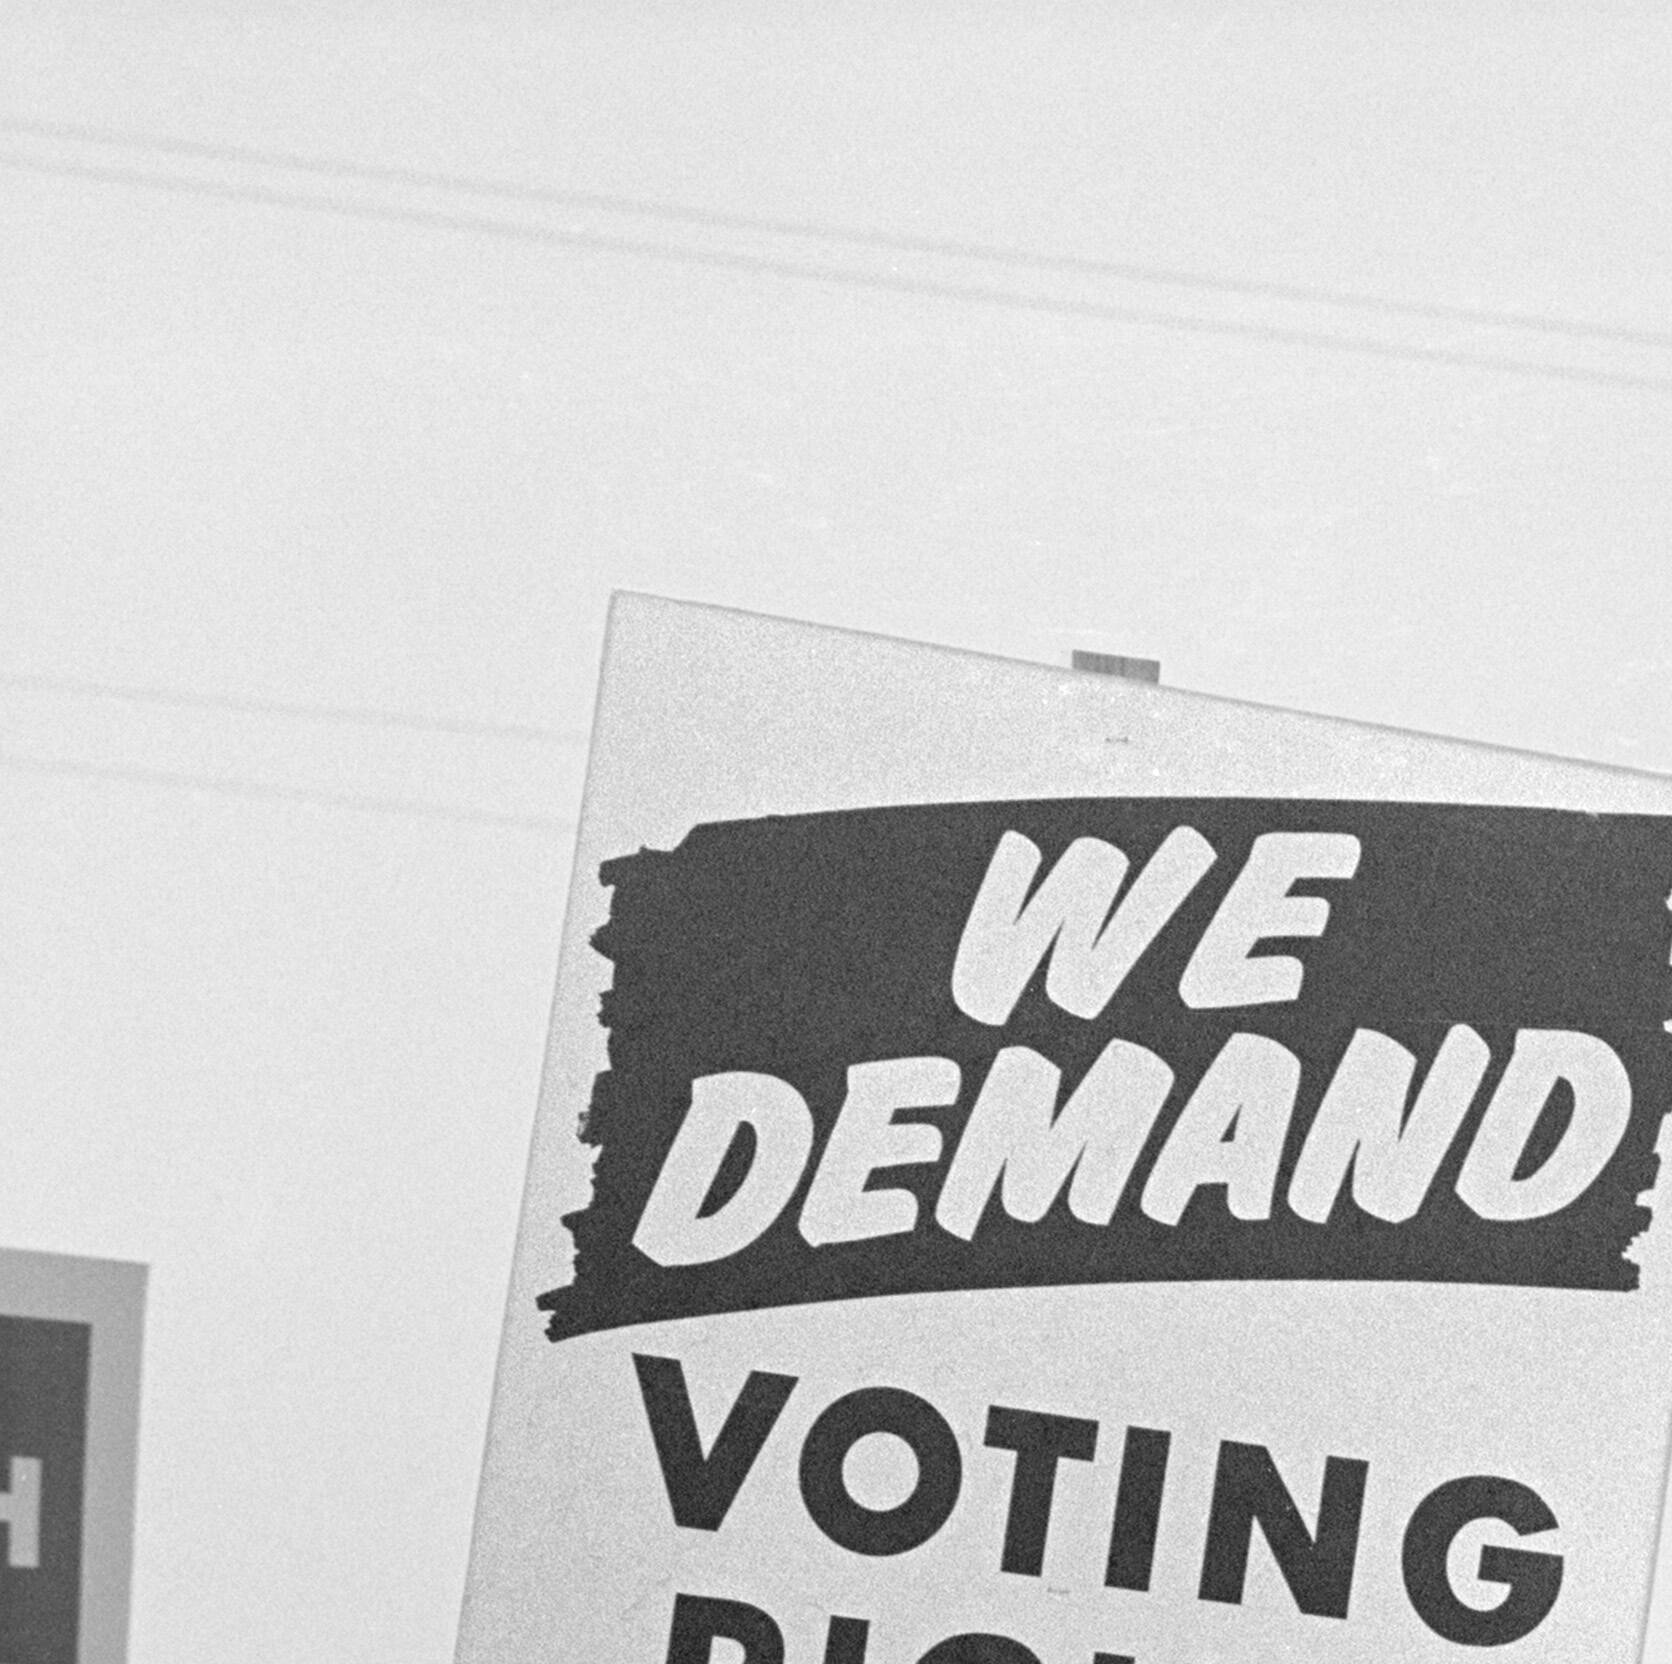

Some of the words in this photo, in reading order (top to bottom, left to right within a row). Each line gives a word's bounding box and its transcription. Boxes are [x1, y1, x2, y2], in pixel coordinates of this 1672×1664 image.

[950, 825, 1363, 1027] WE
[631, 1023, 1634, 1267] DEMAND
[632, 1353, 1563, 1647] VOTING
